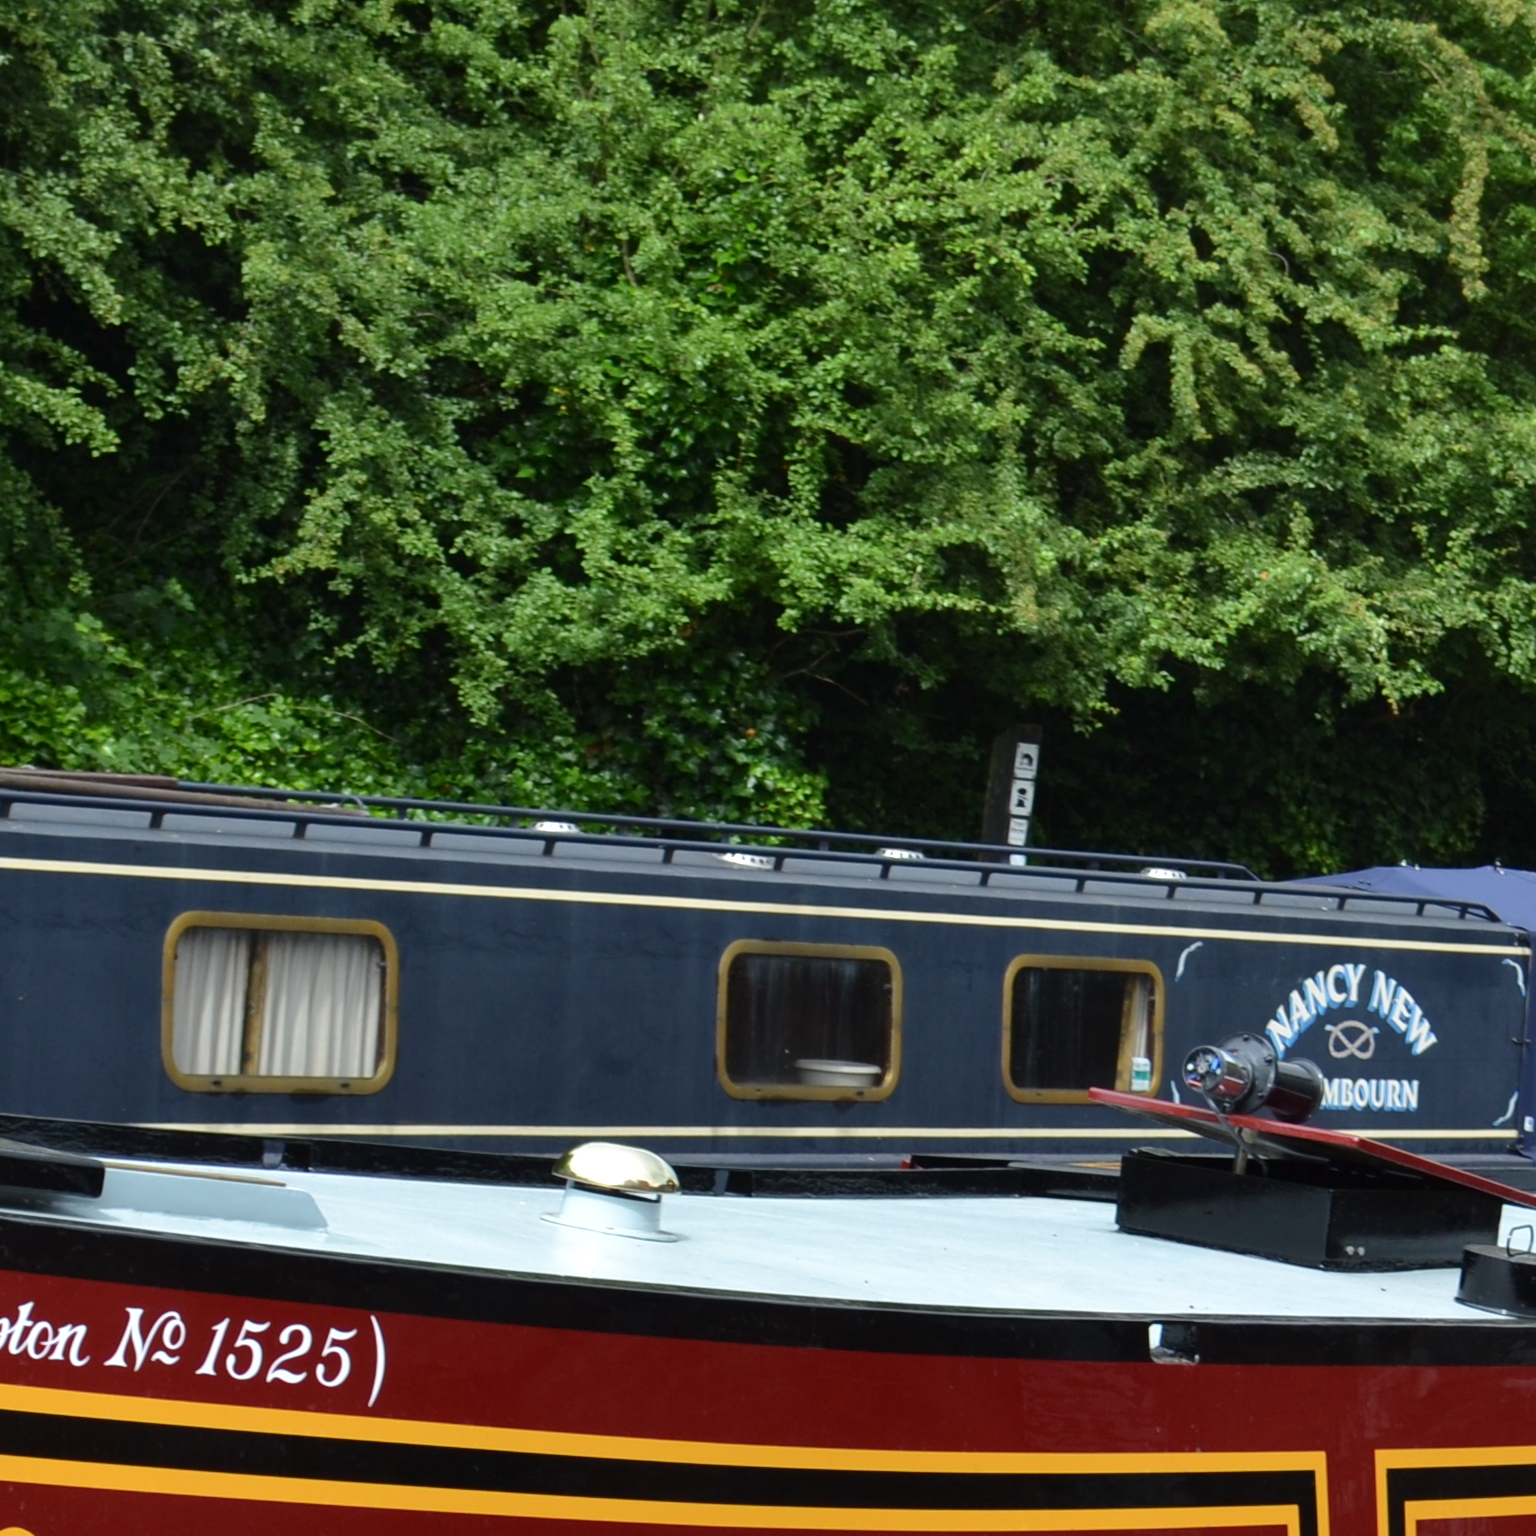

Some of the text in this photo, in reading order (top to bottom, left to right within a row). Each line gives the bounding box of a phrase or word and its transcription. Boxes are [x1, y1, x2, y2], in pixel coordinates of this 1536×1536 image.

[1265, 962, 1438, 1061] NANCY NEW
[1319, 1077, 1420, 1112] MBOURN
[196, 1314, 386, 1408] 1525)
